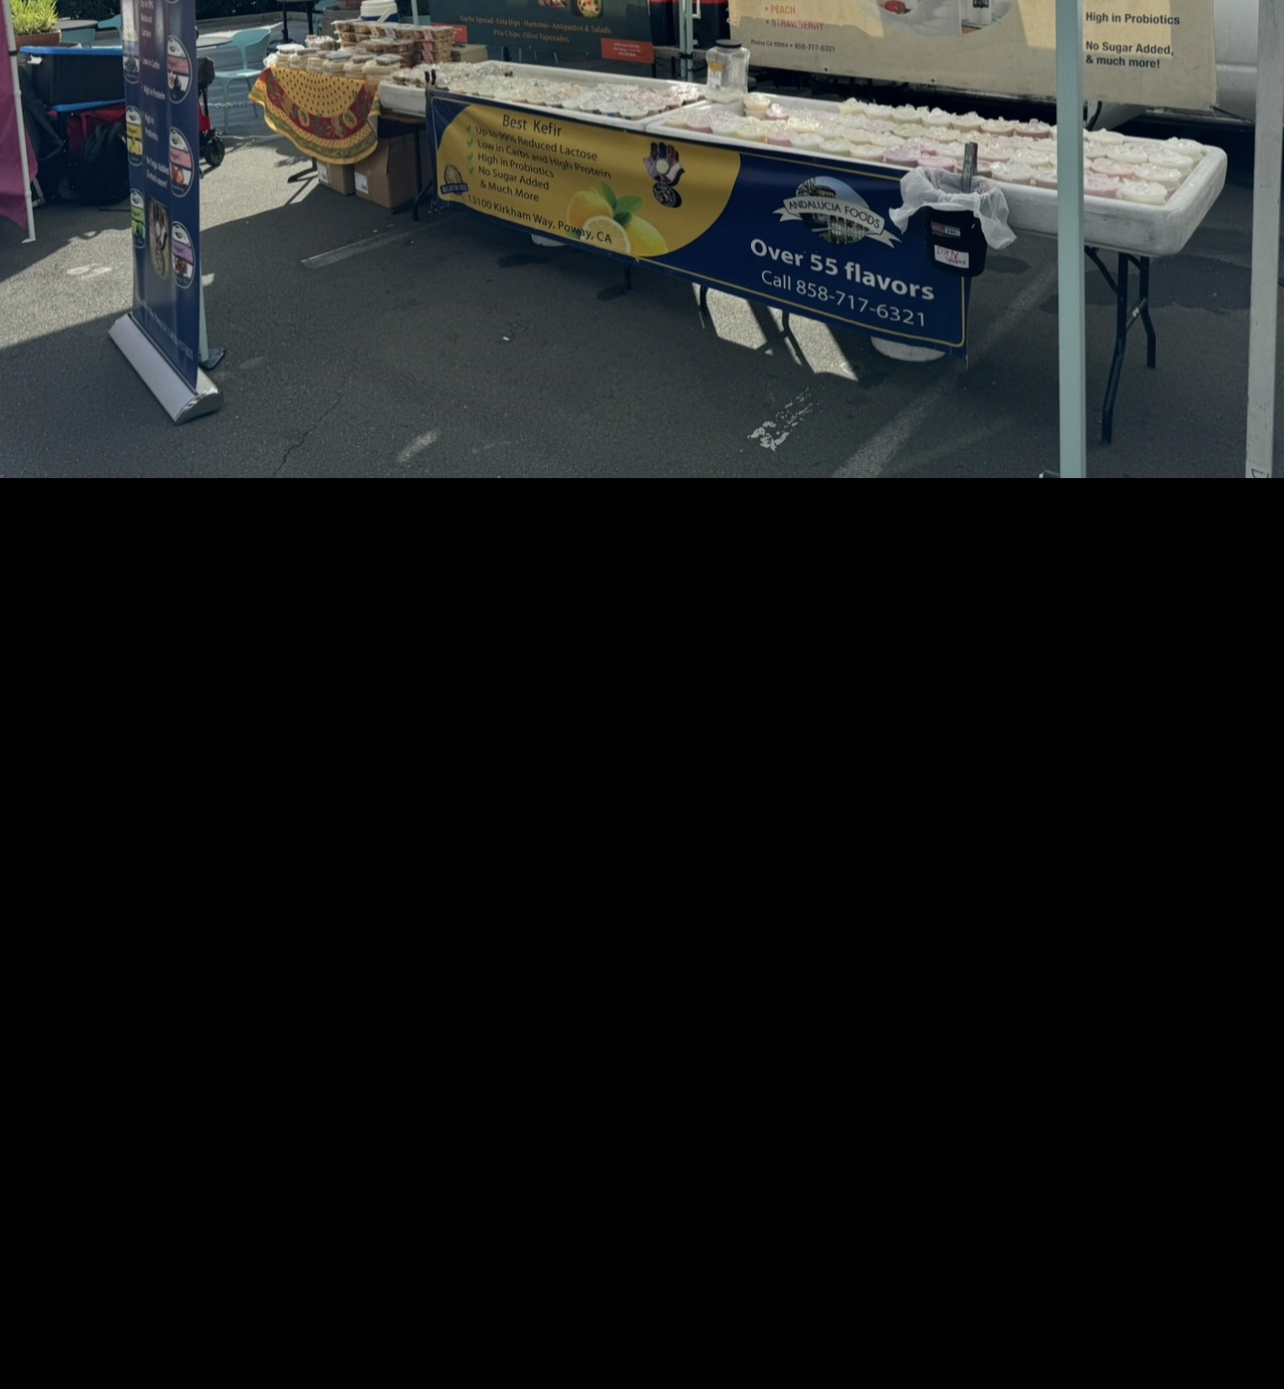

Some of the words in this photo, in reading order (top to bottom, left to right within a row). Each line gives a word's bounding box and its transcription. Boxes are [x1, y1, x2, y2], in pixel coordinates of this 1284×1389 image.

[770, 5, 796, 15] PEACH
[1085, 12, 1109, 23] High
[1112, 13, 1121, 23] in
[1124, 13, 1180, 25] Probiotics
[590, 25, 611, 34] Salads
[771, 19, 824, 30] STRAWBERRY
[1085, 41, 1099, 51] No
[1102, 41, 1132, 54] Sugar
[1136, 43, 1174, 56] Added,
[1085, 55, 1094, 64] &
[1096, 57, 1125, 66] much
[1129, 58, 1160, 68] more!
[503, 114, 526, 131] Best
[533, 120, 562, 137] Kefir
[476, 126, 488, 136] Up
[498, 132, 517, 144] 99%
[517, 135, 557, 153] Reduced
[560, 144, 598, 161] Lactose
[477, 140, 494, 151] Low
[496, 144, 504, 153] in
[506, 147, 530, 160] Carbs
[531, 152, 548, 164] and
[549, 157, 573, 171] High
[574, 162, 611, 179] Protein
[477, 153, 499, 165] High
[500, 157, 508, 167] in
[510, 160, 554, 178] Probiotics
[478, 166, 491, 177] No
[492, 168, 517, 183] Sugar
[519, 174, 550, 190] Added
[480, 180, 486, 189] &
[488, 181, 513, 196] Much
[515, 188, 539, 202] More
[468, 194, 492, 210] 13100
[494, 202, 531, 221] Kirkham
[532, 212, 555, 230] Way,
[557, 220, 594, 240] Poway,
[596, 231, 612, 244] CA
[788, 200, 841, 212] ANDALUCIA
[844, 205, 880, 229] FOODS
[751, 238, 804, 266] Over
[810, 254, 838, 276] 55
[844, 261, 935, 300] flavors
[761, 270, 791, 291] Call
[796, 279, 924, 327] 858-717-6321
